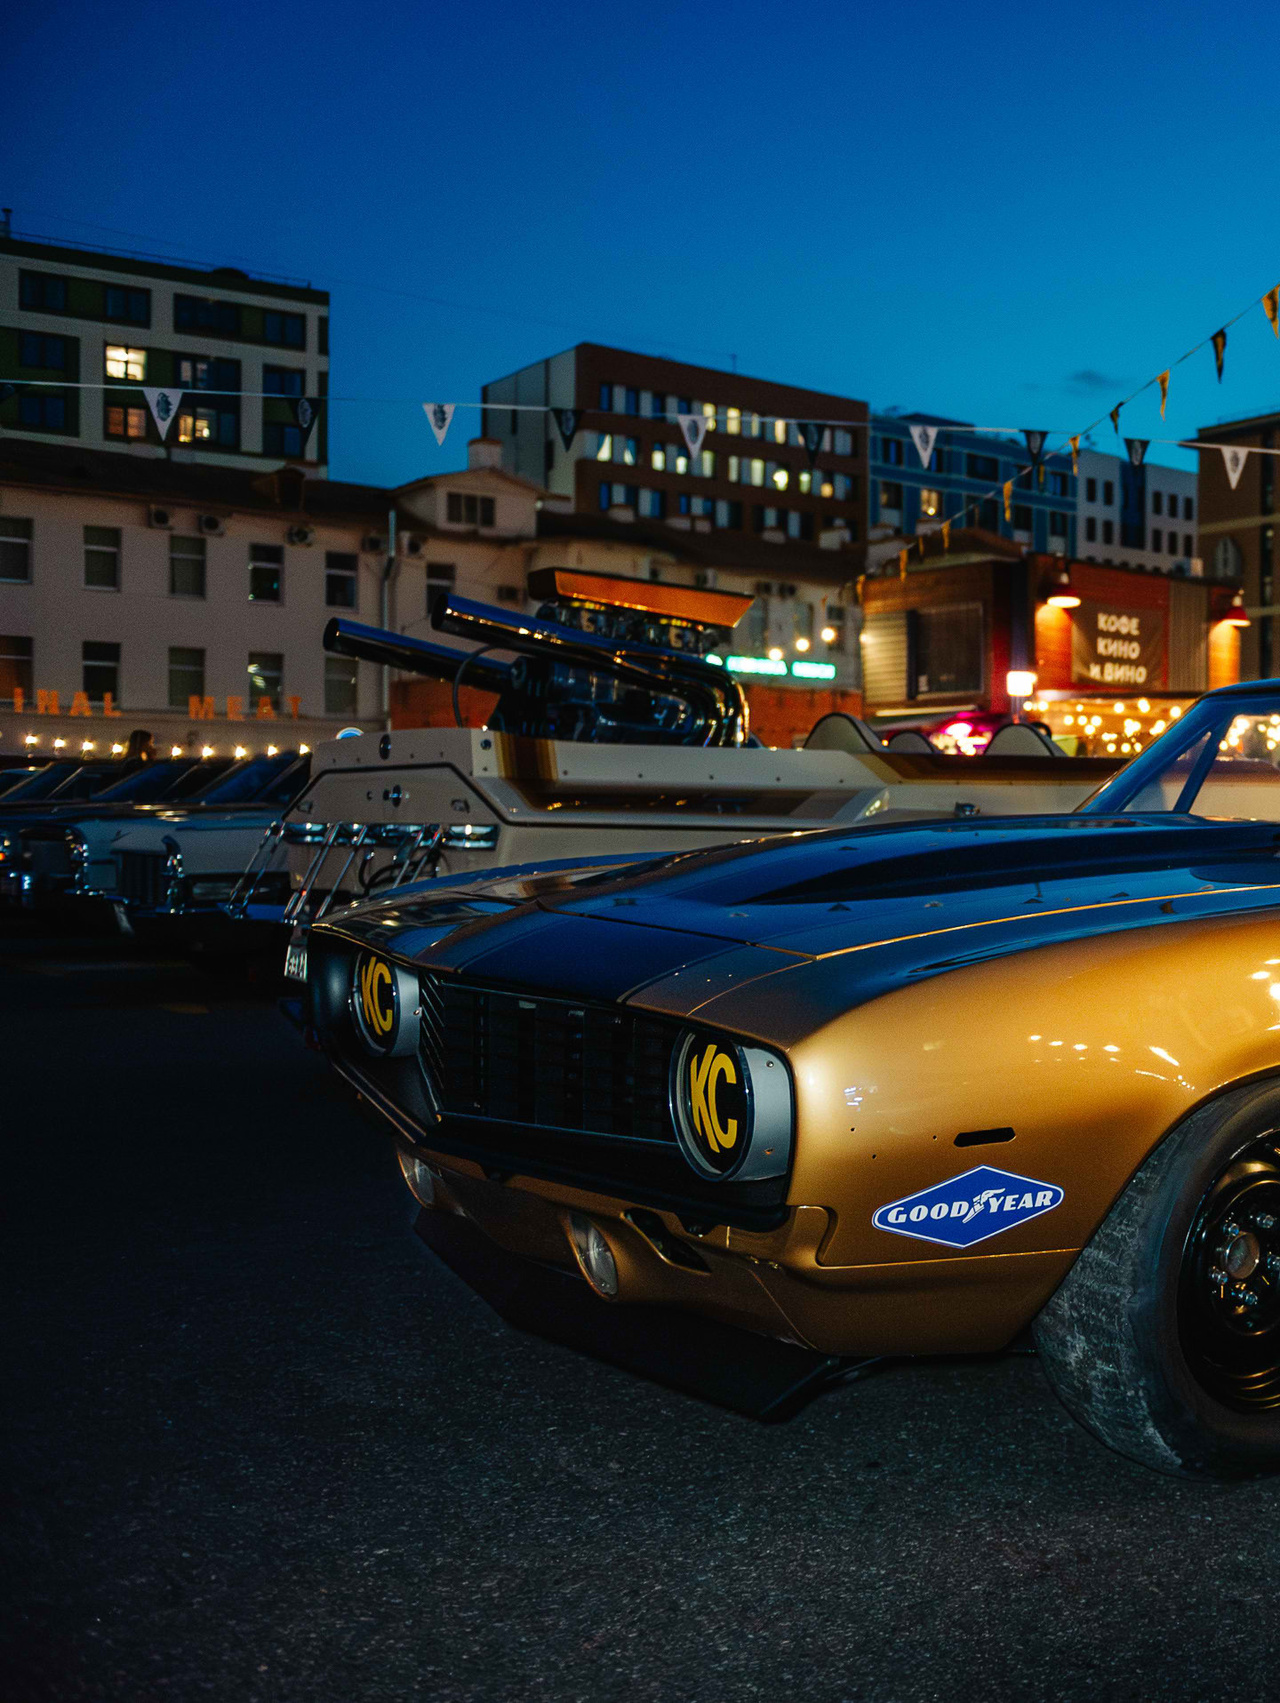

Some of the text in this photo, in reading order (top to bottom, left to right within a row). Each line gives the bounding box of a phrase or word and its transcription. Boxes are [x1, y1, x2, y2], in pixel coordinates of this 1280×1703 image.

[1097, 613, 1140, 636] КОФЕ
[1097, 637, 1141, 660] КИНО
[1104, 662, 1147, 684] ВИНО
[187, 694, 302, 721] MEAT
[361, 955, 394, 1037] KC
[690, 1043, 738, 1154] KC
